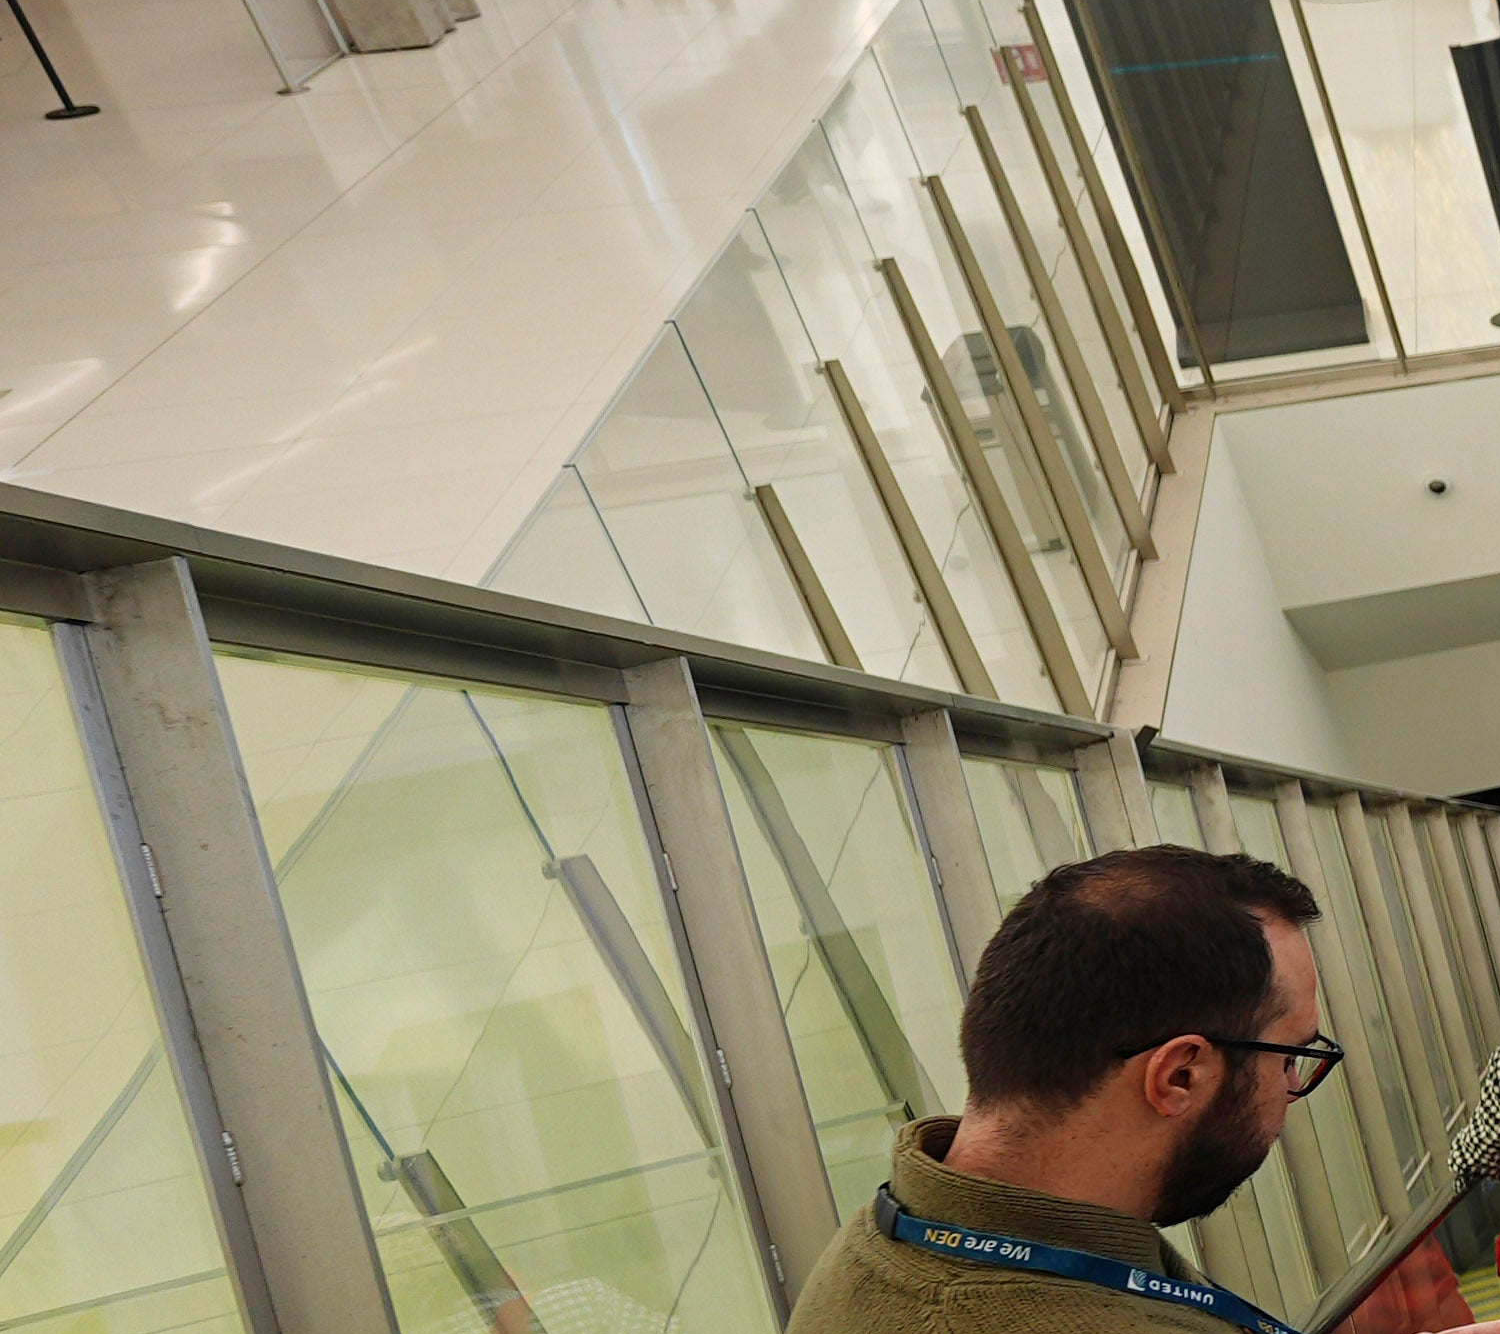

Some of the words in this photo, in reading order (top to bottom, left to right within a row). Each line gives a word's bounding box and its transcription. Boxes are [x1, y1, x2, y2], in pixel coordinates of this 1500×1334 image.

[923, 1227, 963, 1248] DEN
[964, 1236, 998, 1253] are
[999, 1242, 1032, 1262] We
[1148, 1279, 1215, 1306] UNITED
